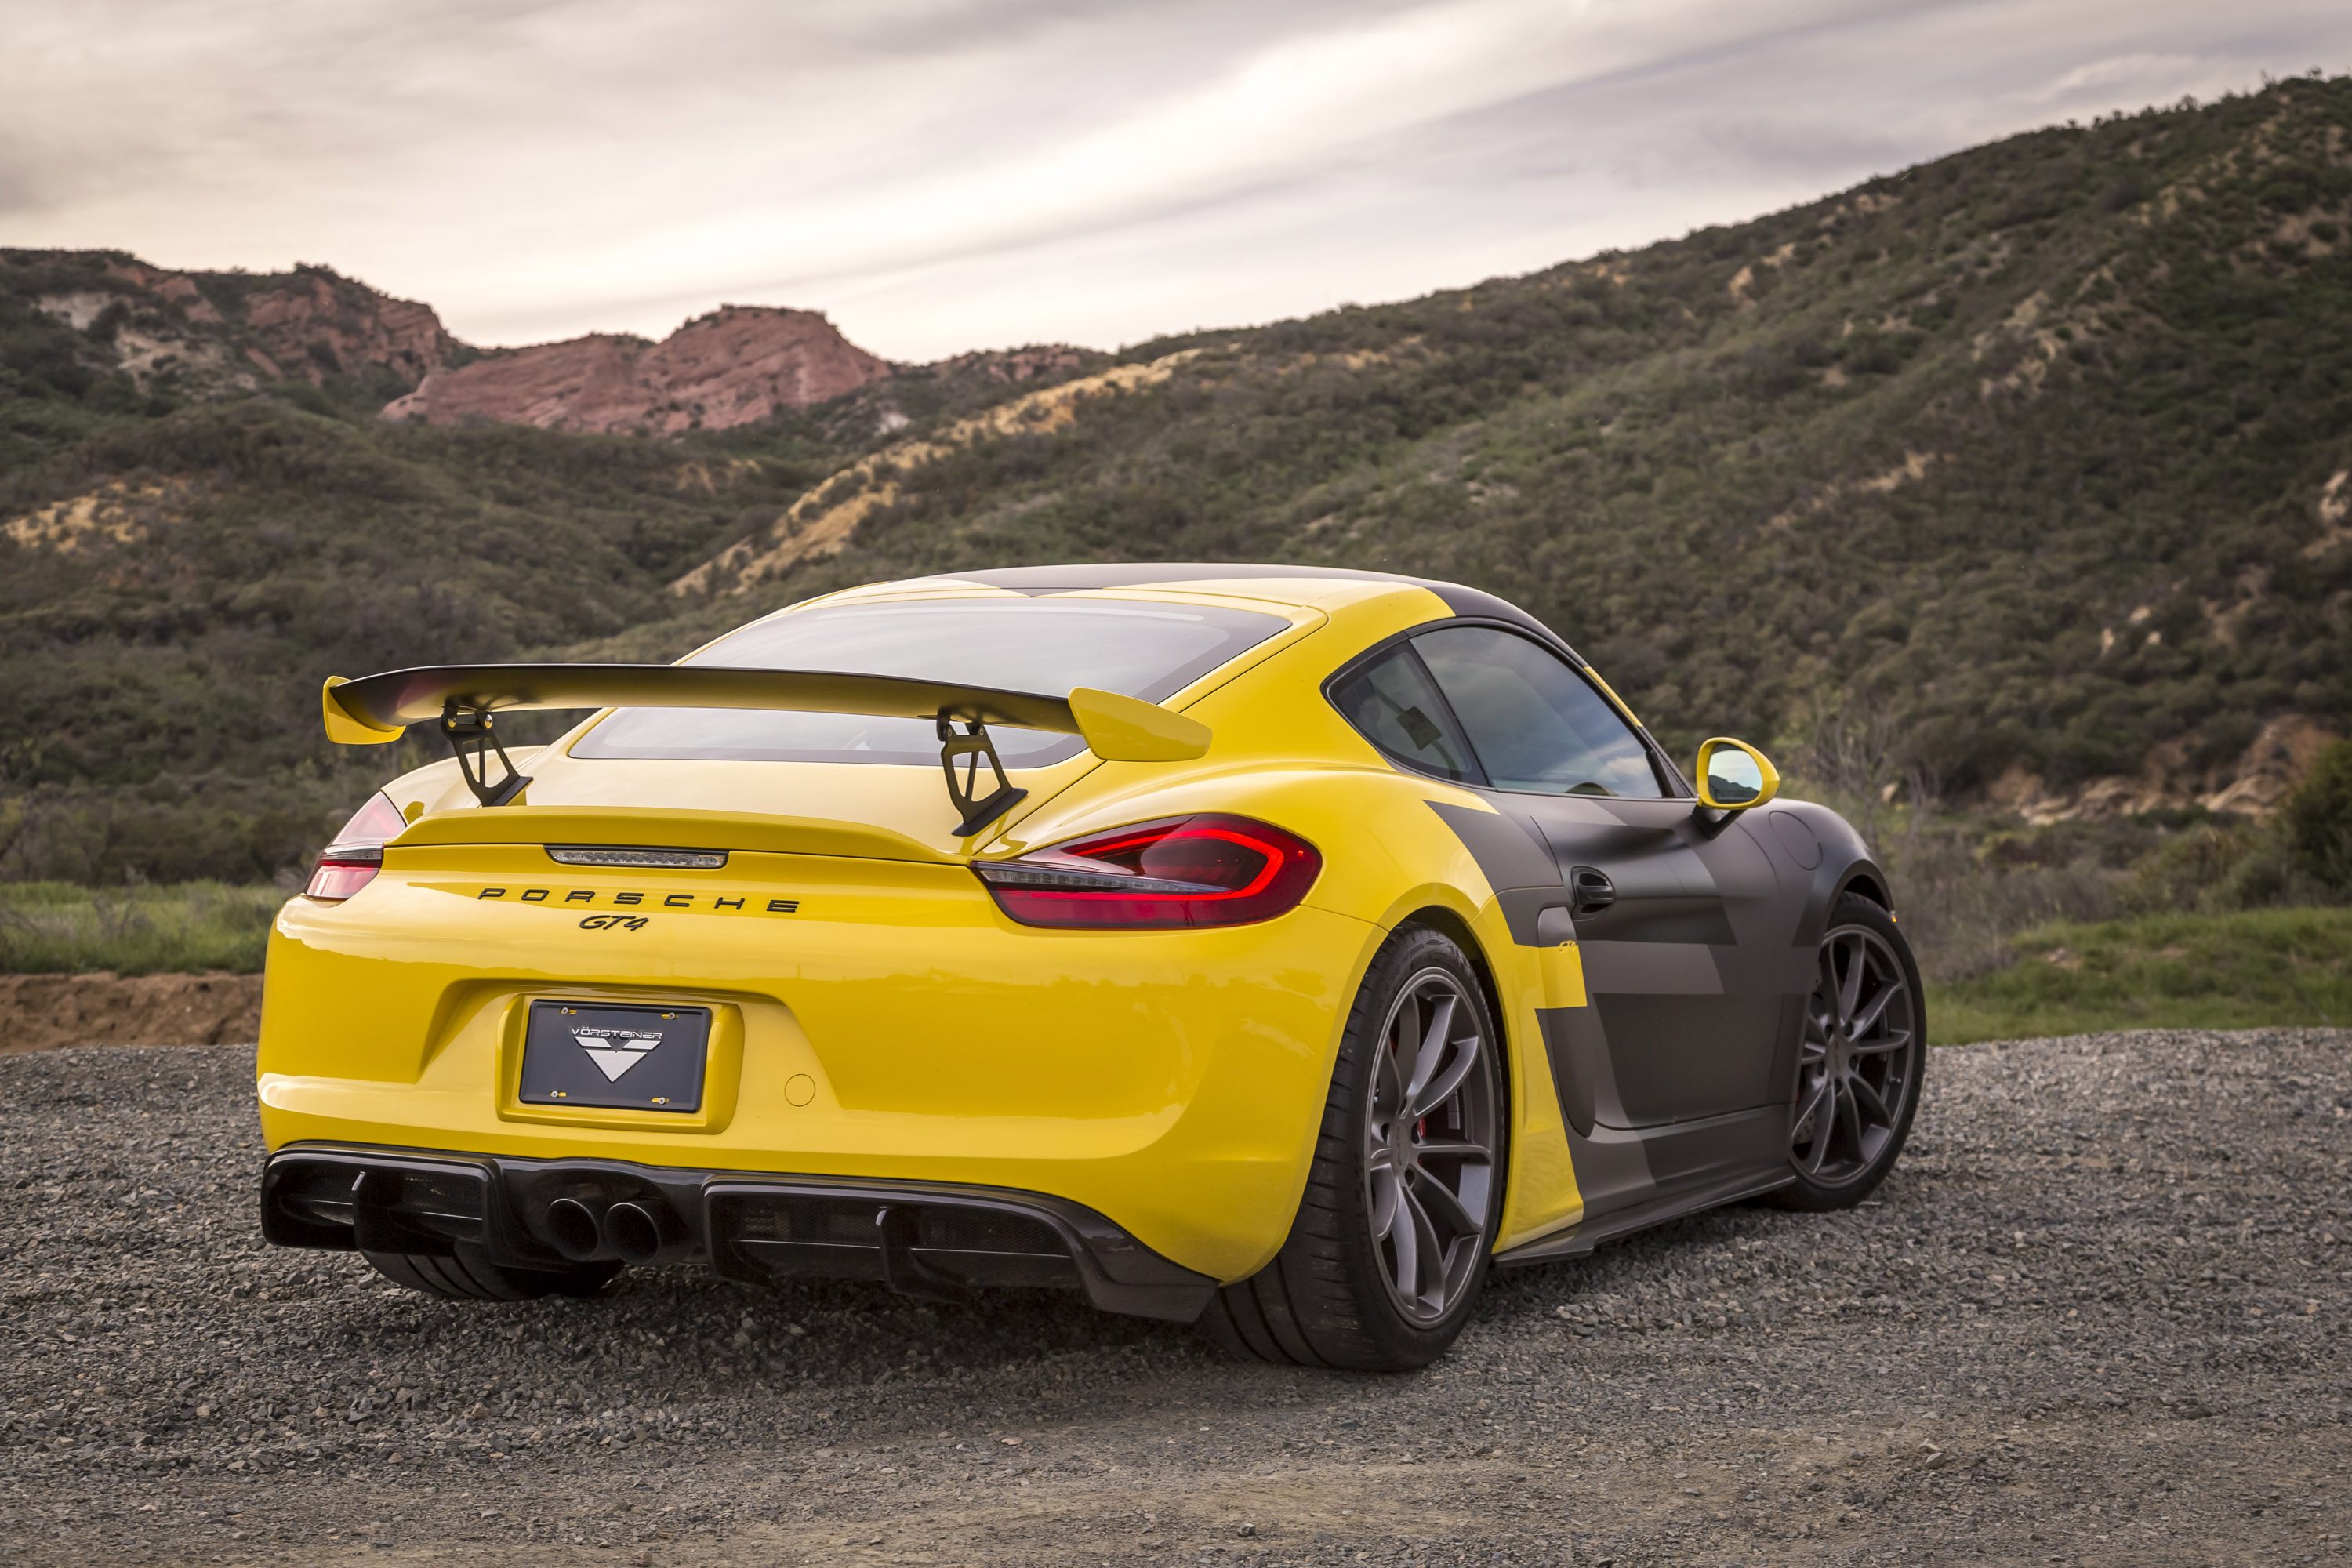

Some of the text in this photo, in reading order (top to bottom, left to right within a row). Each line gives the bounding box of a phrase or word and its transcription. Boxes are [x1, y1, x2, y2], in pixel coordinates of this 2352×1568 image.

[477, 887, 800, 913] PORSCHE
[579, 915, 649, 931] GT4
[571, 1026, 663, 1039] VÖRSTEINER
